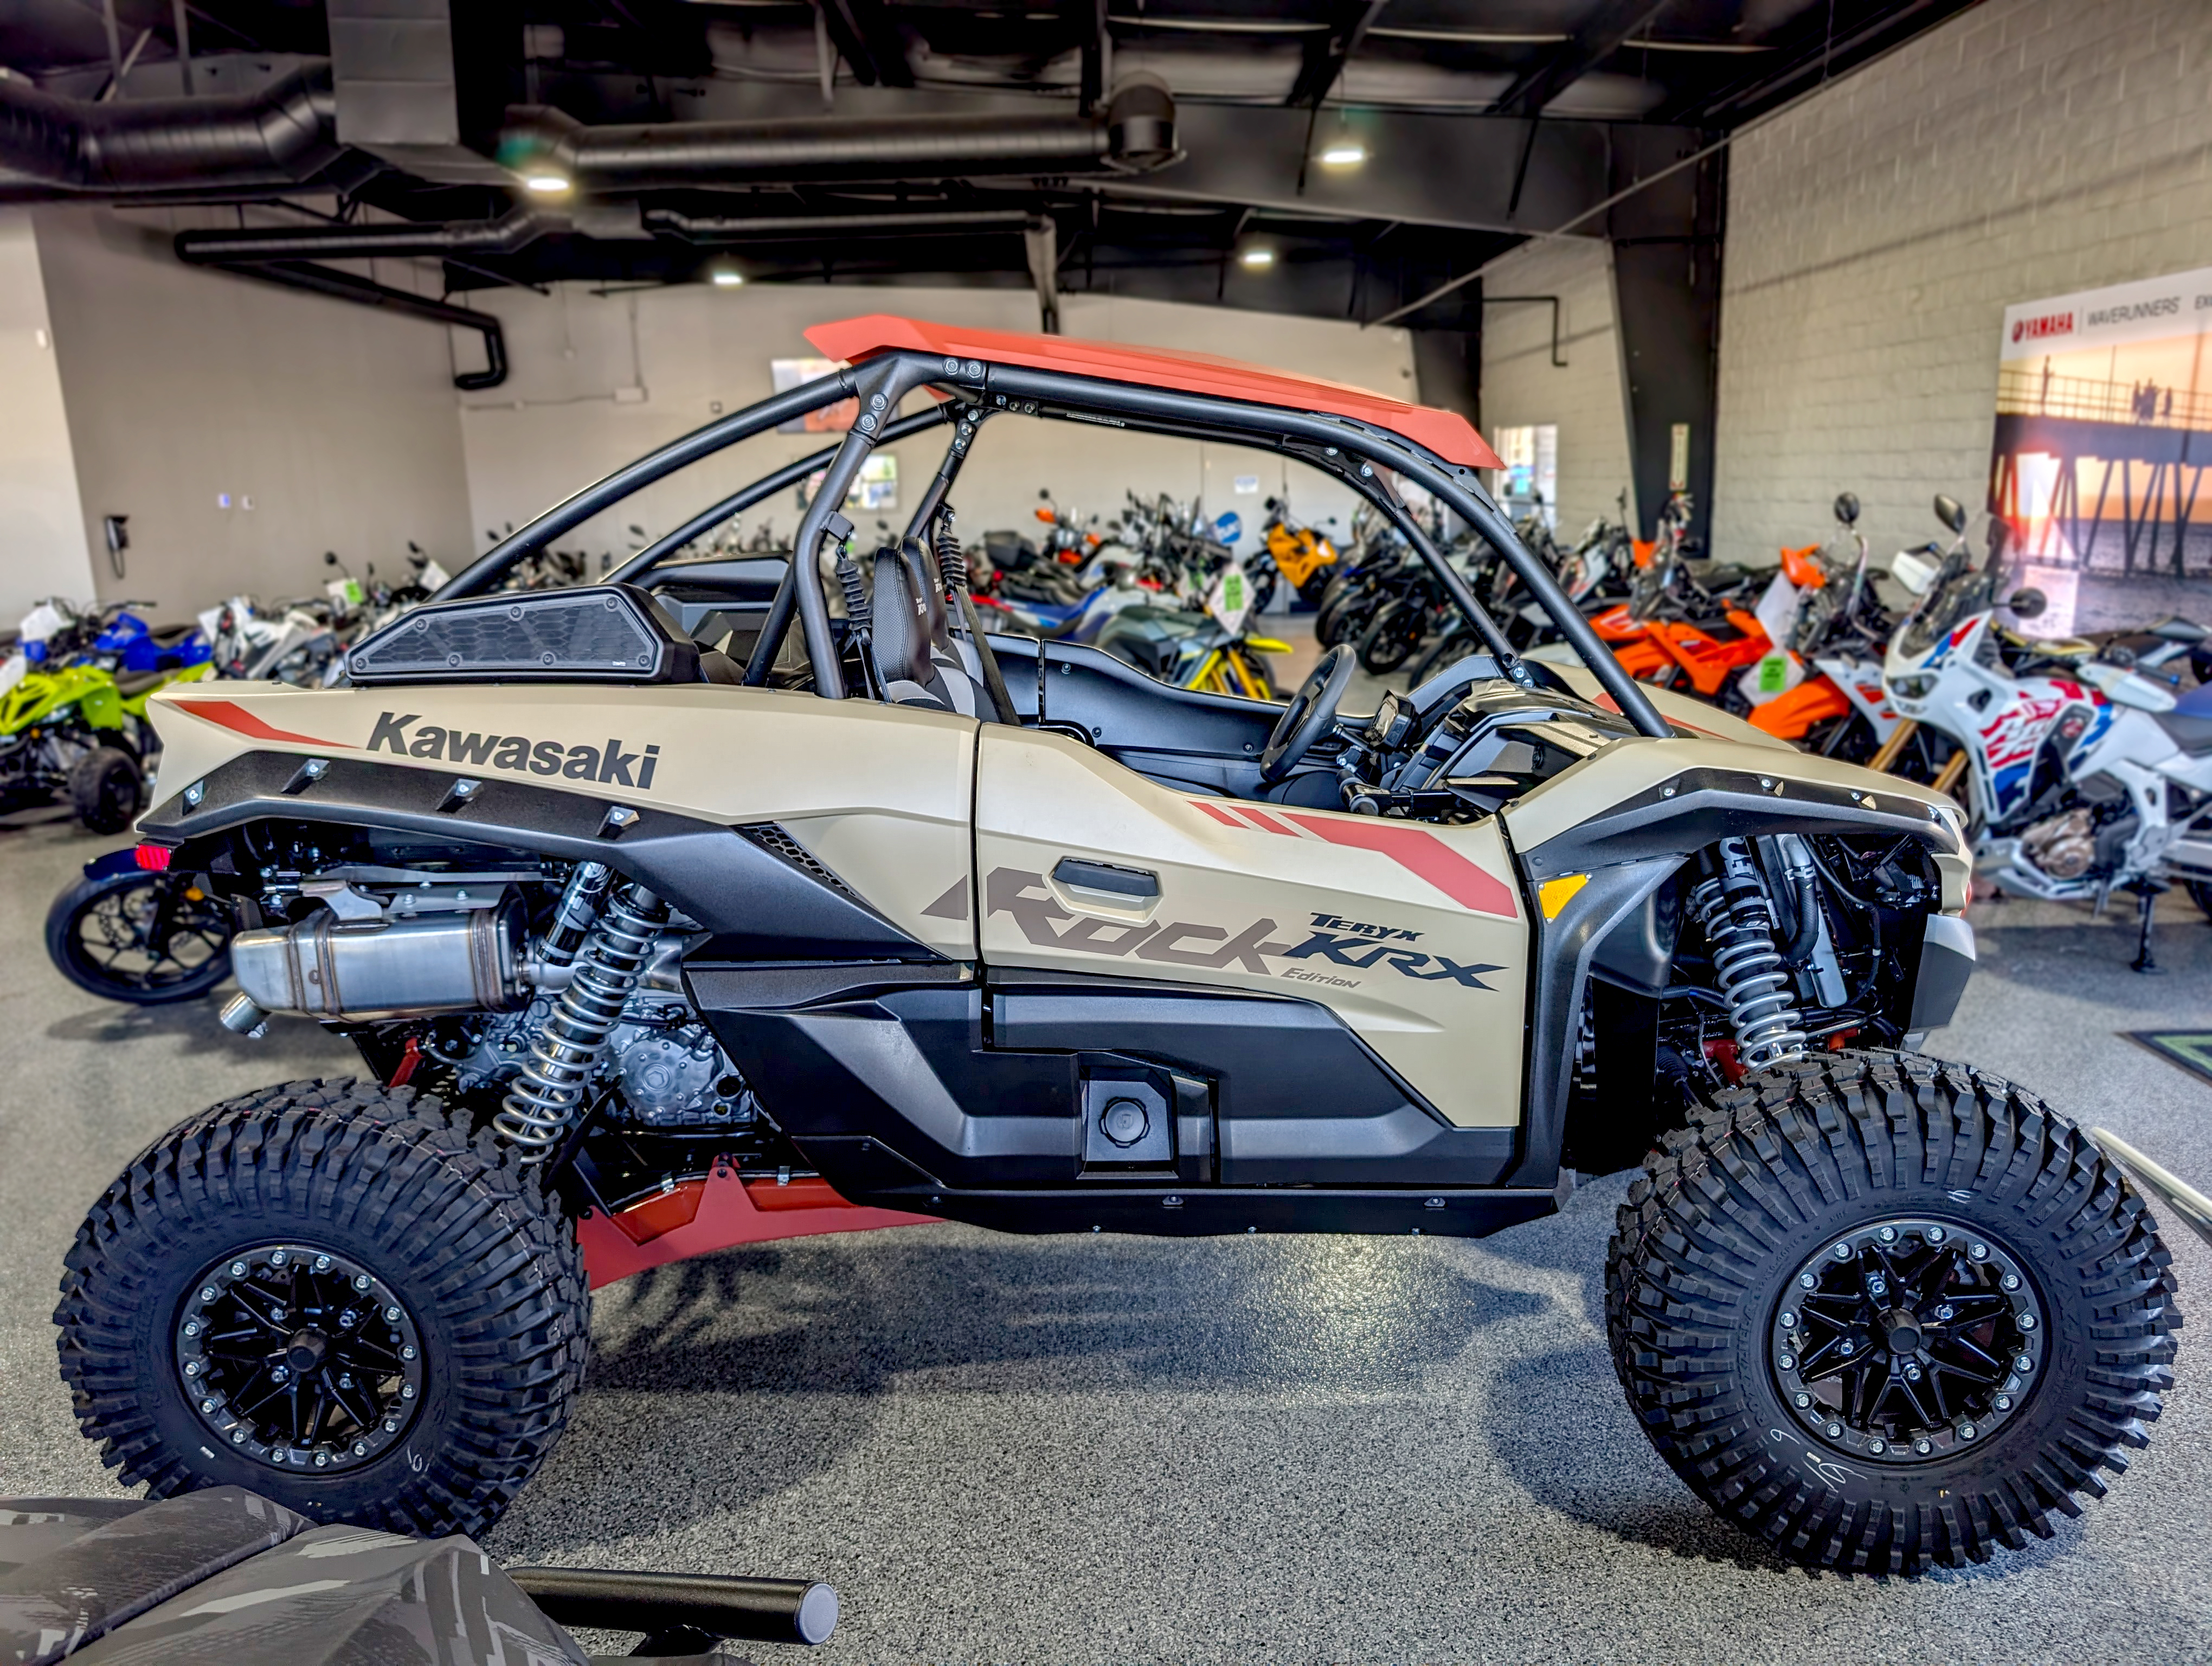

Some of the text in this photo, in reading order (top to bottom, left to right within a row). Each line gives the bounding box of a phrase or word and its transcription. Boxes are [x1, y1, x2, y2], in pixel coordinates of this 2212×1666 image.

[2025, 311, 2073, 341] YAMAHA
[366, 711, 661, 790] Kawasaki
[1281, 930, 1510, 992] KRX
